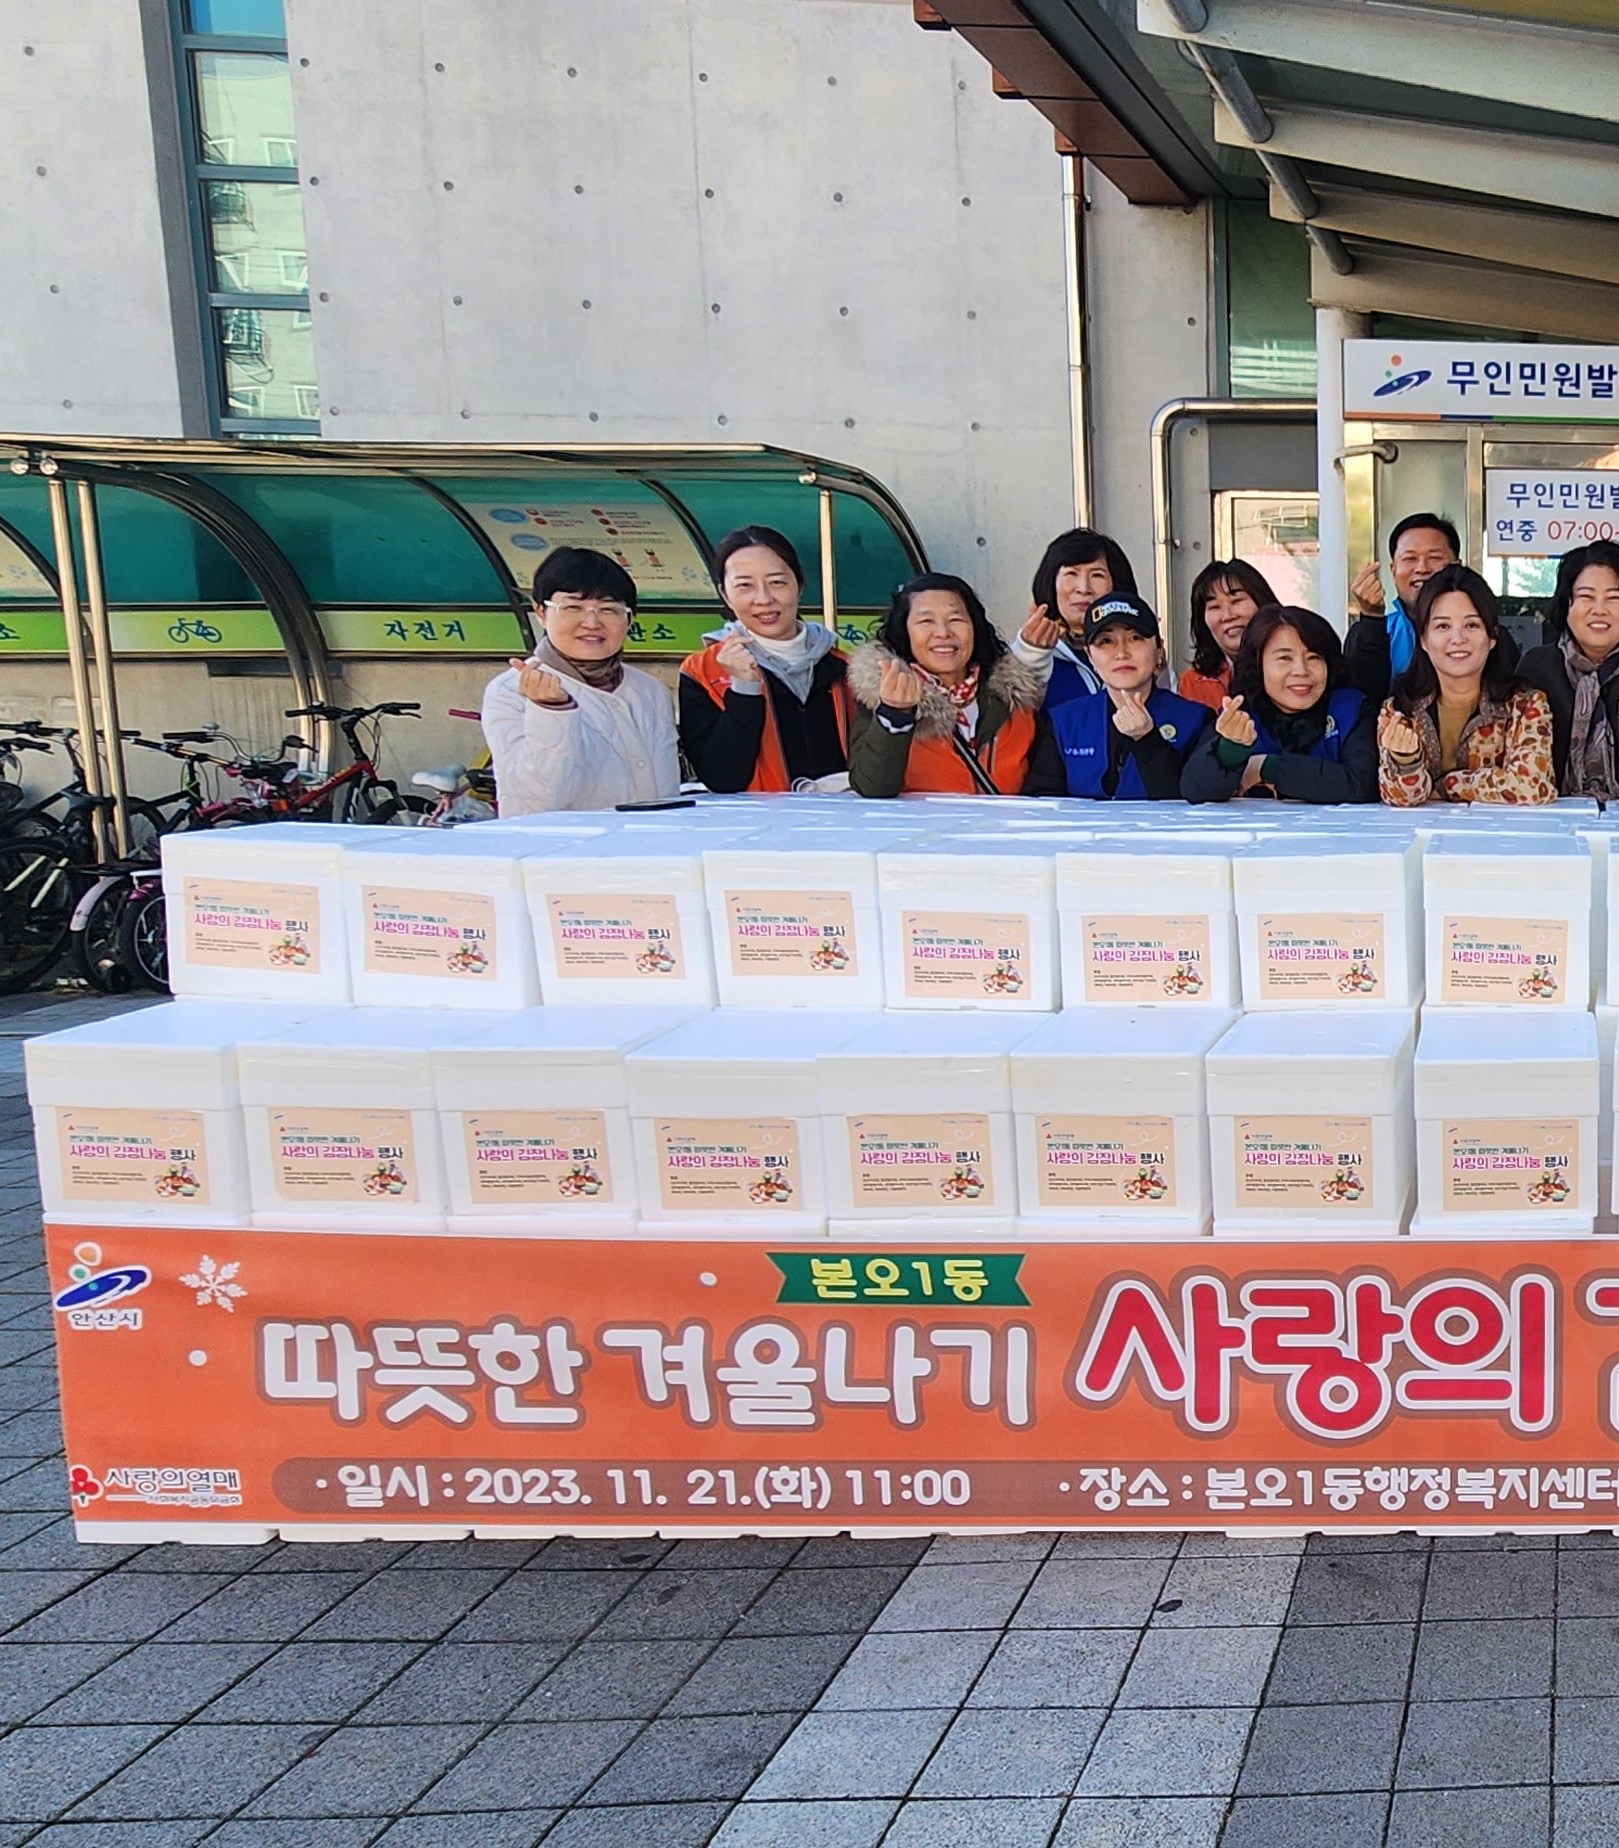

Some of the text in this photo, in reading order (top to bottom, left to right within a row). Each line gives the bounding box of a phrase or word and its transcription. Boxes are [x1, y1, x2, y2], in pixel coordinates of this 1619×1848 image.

[1496, 519, 1537, 542] 연중
[383, 619, 466, 642] 자전거
[810, 1258, 989, 1302] 본오1동
[70, 1310, 143, 1328] 안산시
[261, 1320, 583, 1425] 따뜻한
[602, 1322, 1029, 1427] 겨울나기
[1074, 1272, 1556, 1440] 사랑의
[105, 1467, 240, 1493] 사랑의열매
[465, 1468, 592, 1504] 2023.
[607, 1469, 668, 1505] 11.
[686, 1466, 832, 1509] 21.(화)
[845, 1469, 970, 1505] 11:00
